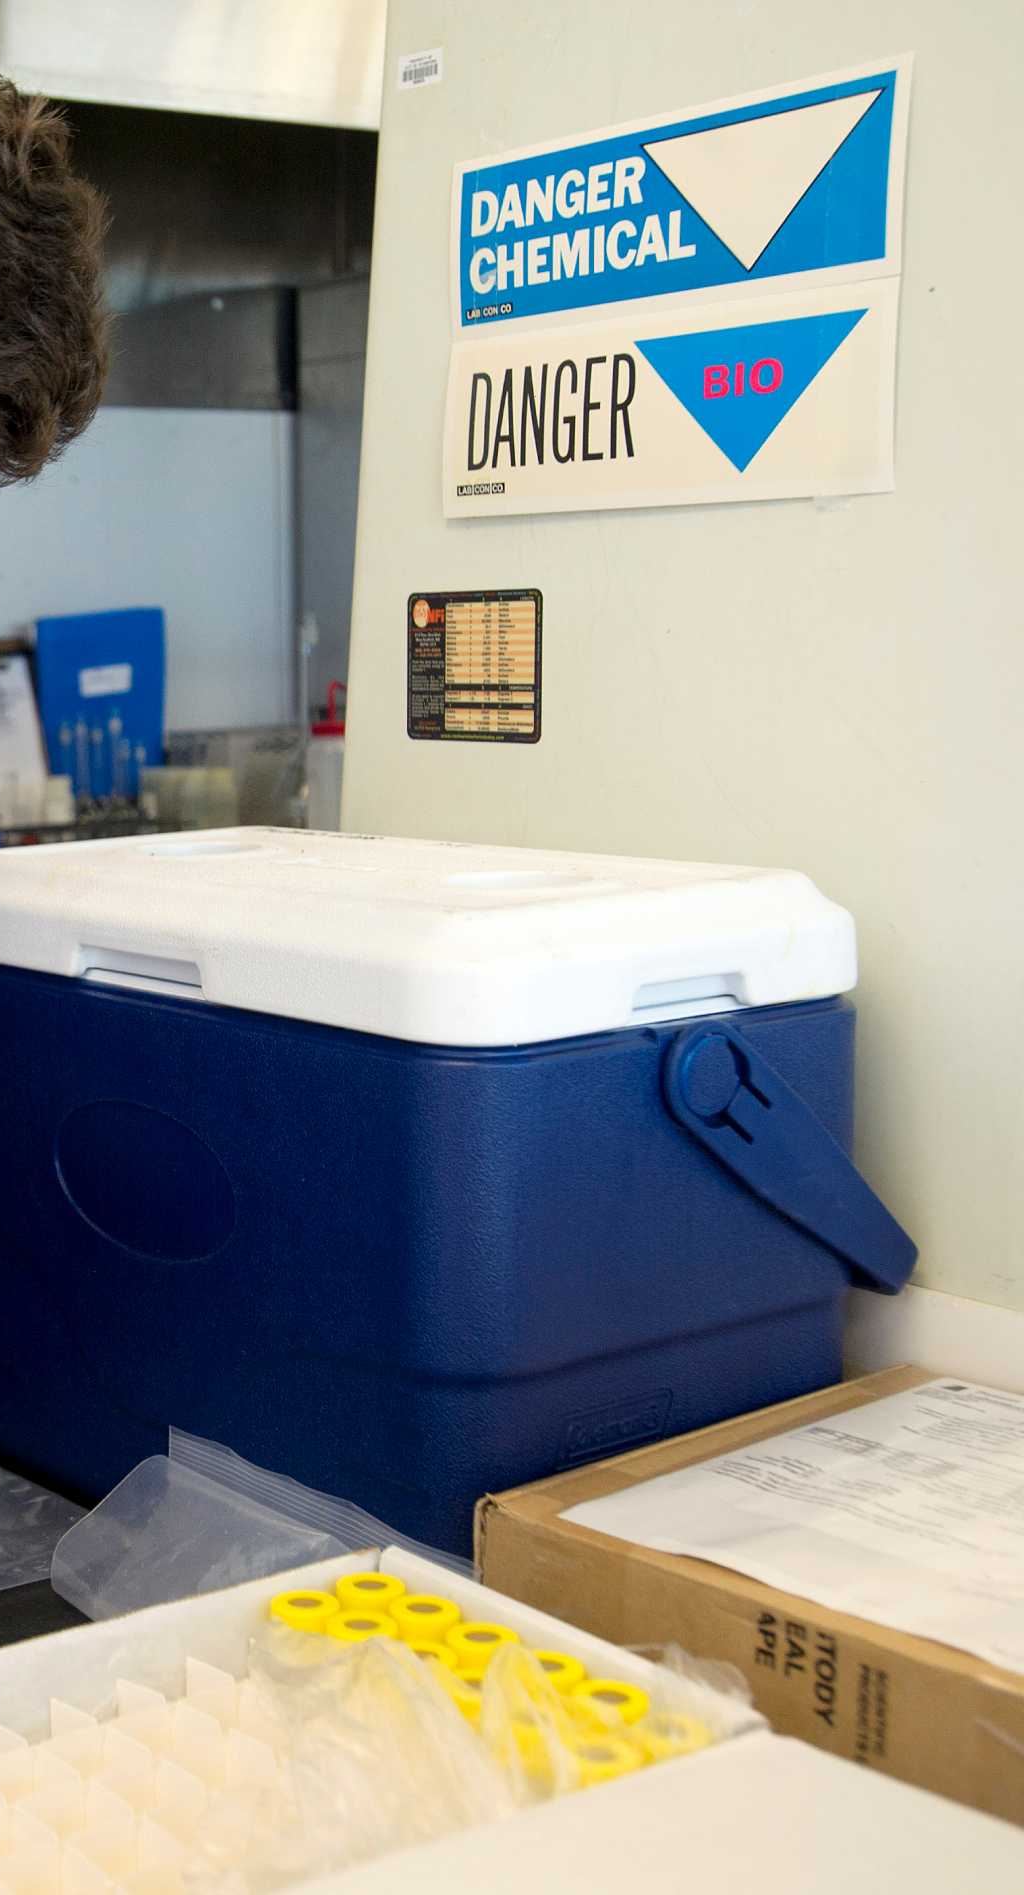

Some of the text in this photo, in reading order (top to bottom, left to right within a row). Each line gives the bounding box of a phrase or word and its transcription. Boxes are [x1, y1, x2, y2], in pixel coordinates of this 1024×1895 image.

[470, 155, 646, 238] DANGER
[469, 210, 697, 295] CHEMICAL
[466, 303, 512, 320] LAB CON CO
[703, 357, 784, 401] BIO
[467, 353, 637, 471] DANGER
[458, 485, 473, 496] LAB
[474, 484, 490, 495] CON
